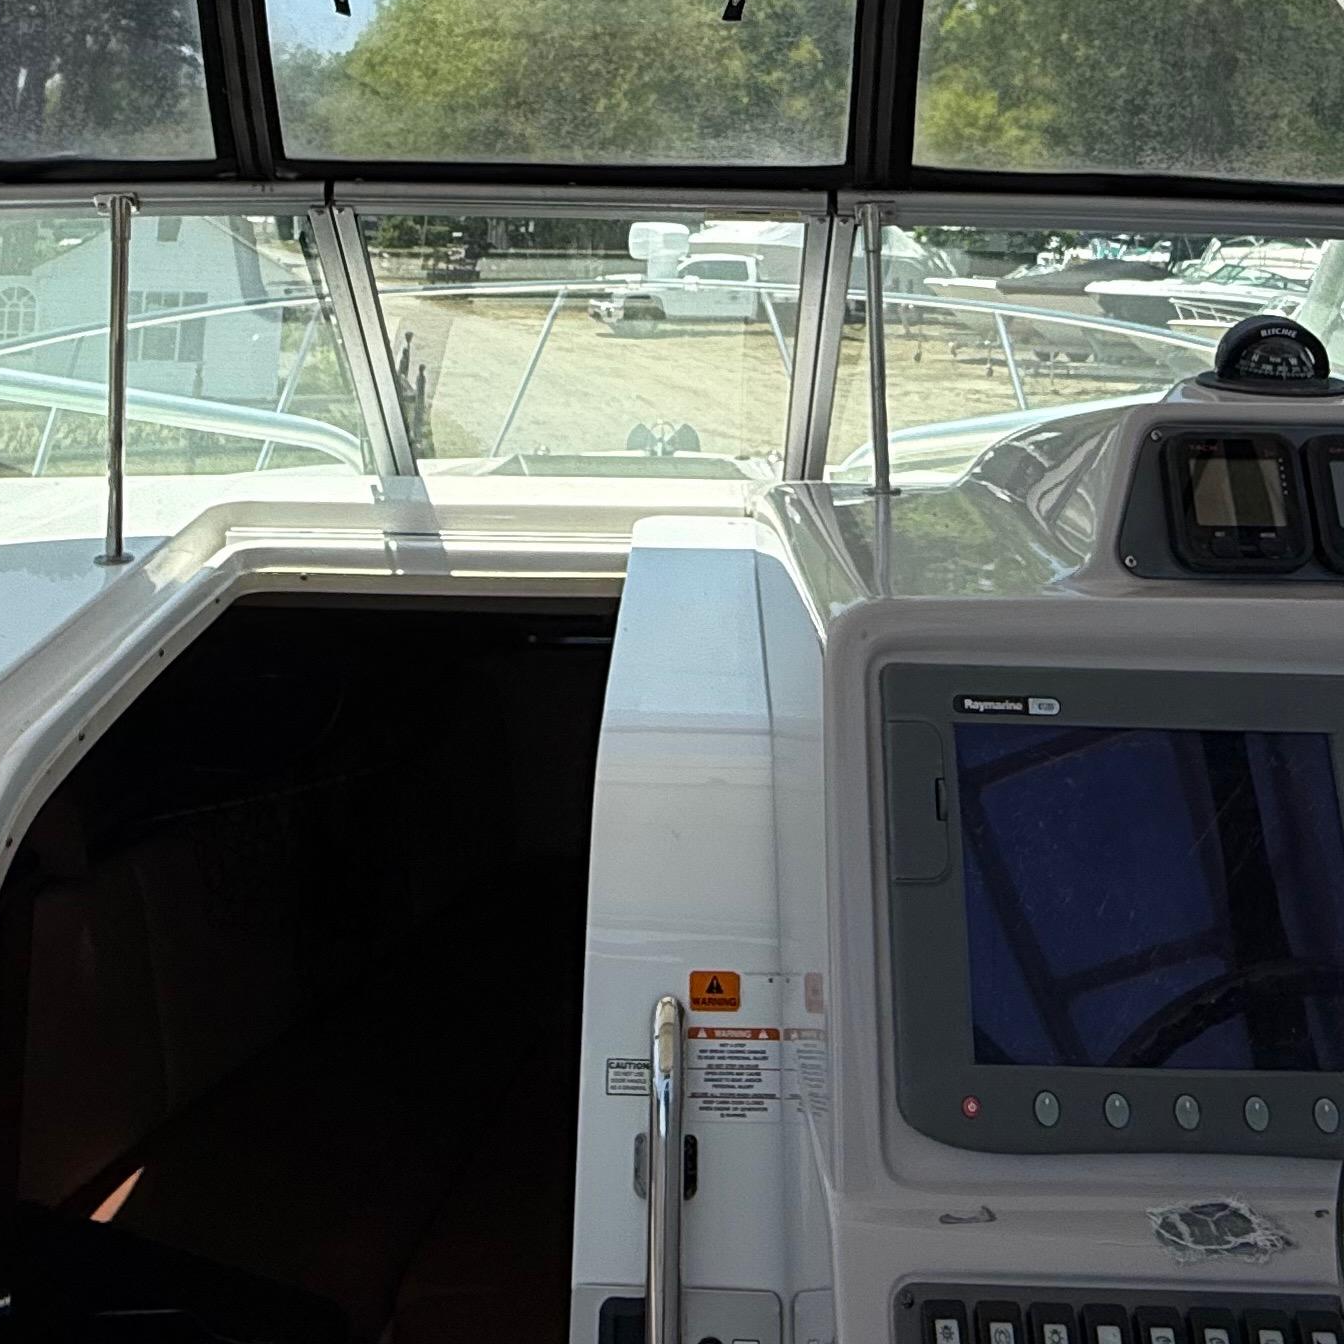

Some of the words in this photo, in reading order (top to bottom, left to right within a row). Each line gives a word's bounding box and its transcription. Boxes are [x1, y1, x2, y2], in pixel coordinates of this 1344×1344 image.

[964, 698, 1023, 712] Raymarine
[692, 997, 737, 1007] WARNING
[714, 1029, 752, 1039] WARNING
[609, 1062, 650, 1070] CAUTION
